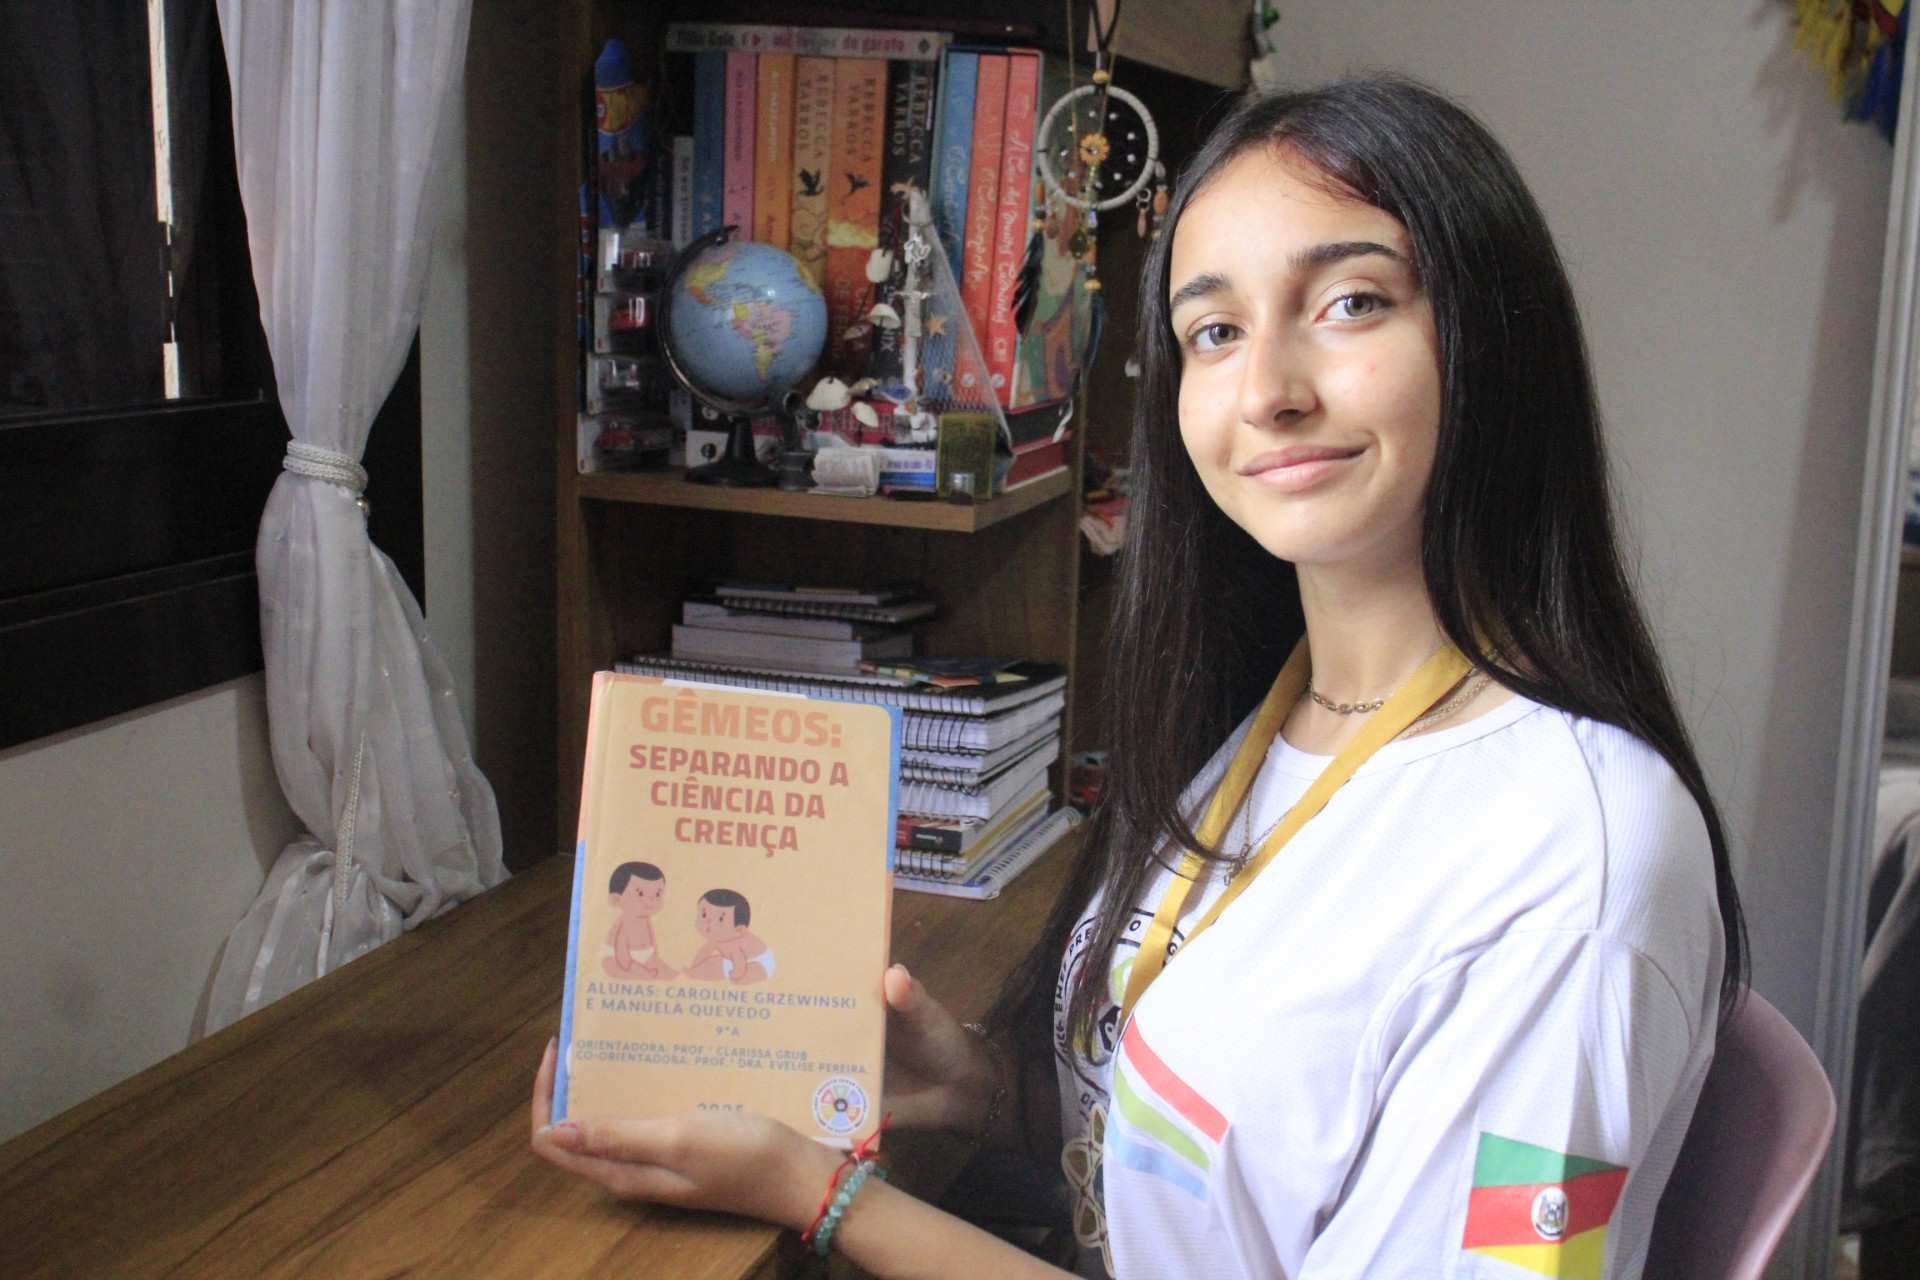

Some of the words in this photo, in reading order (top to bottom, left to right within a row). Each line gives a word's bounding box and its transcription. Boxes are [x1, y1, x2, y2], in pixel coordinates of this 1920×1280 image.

[640, 688, 842, 748] GÊMEOS:
[629, 744, 821, 784] SEPARANDO
[829, 762, 849, 787] A
[651, 776, 775, 815] CIÊNCIA
[784, 792, 826, 819] DA
[674, 817, 799, 858] CRENÇA
[586, 998, 593, 1010] E
[601, 1000, 684, 1015] MANUELA
[689, 1005, 771, 1020] QUEVEDO
[665, 986, 749, 1004] CAROLINE
[754, 992, 857, 1009] GRZEWINSKI
[716, 1046, 772, 1059] CLARISSA
